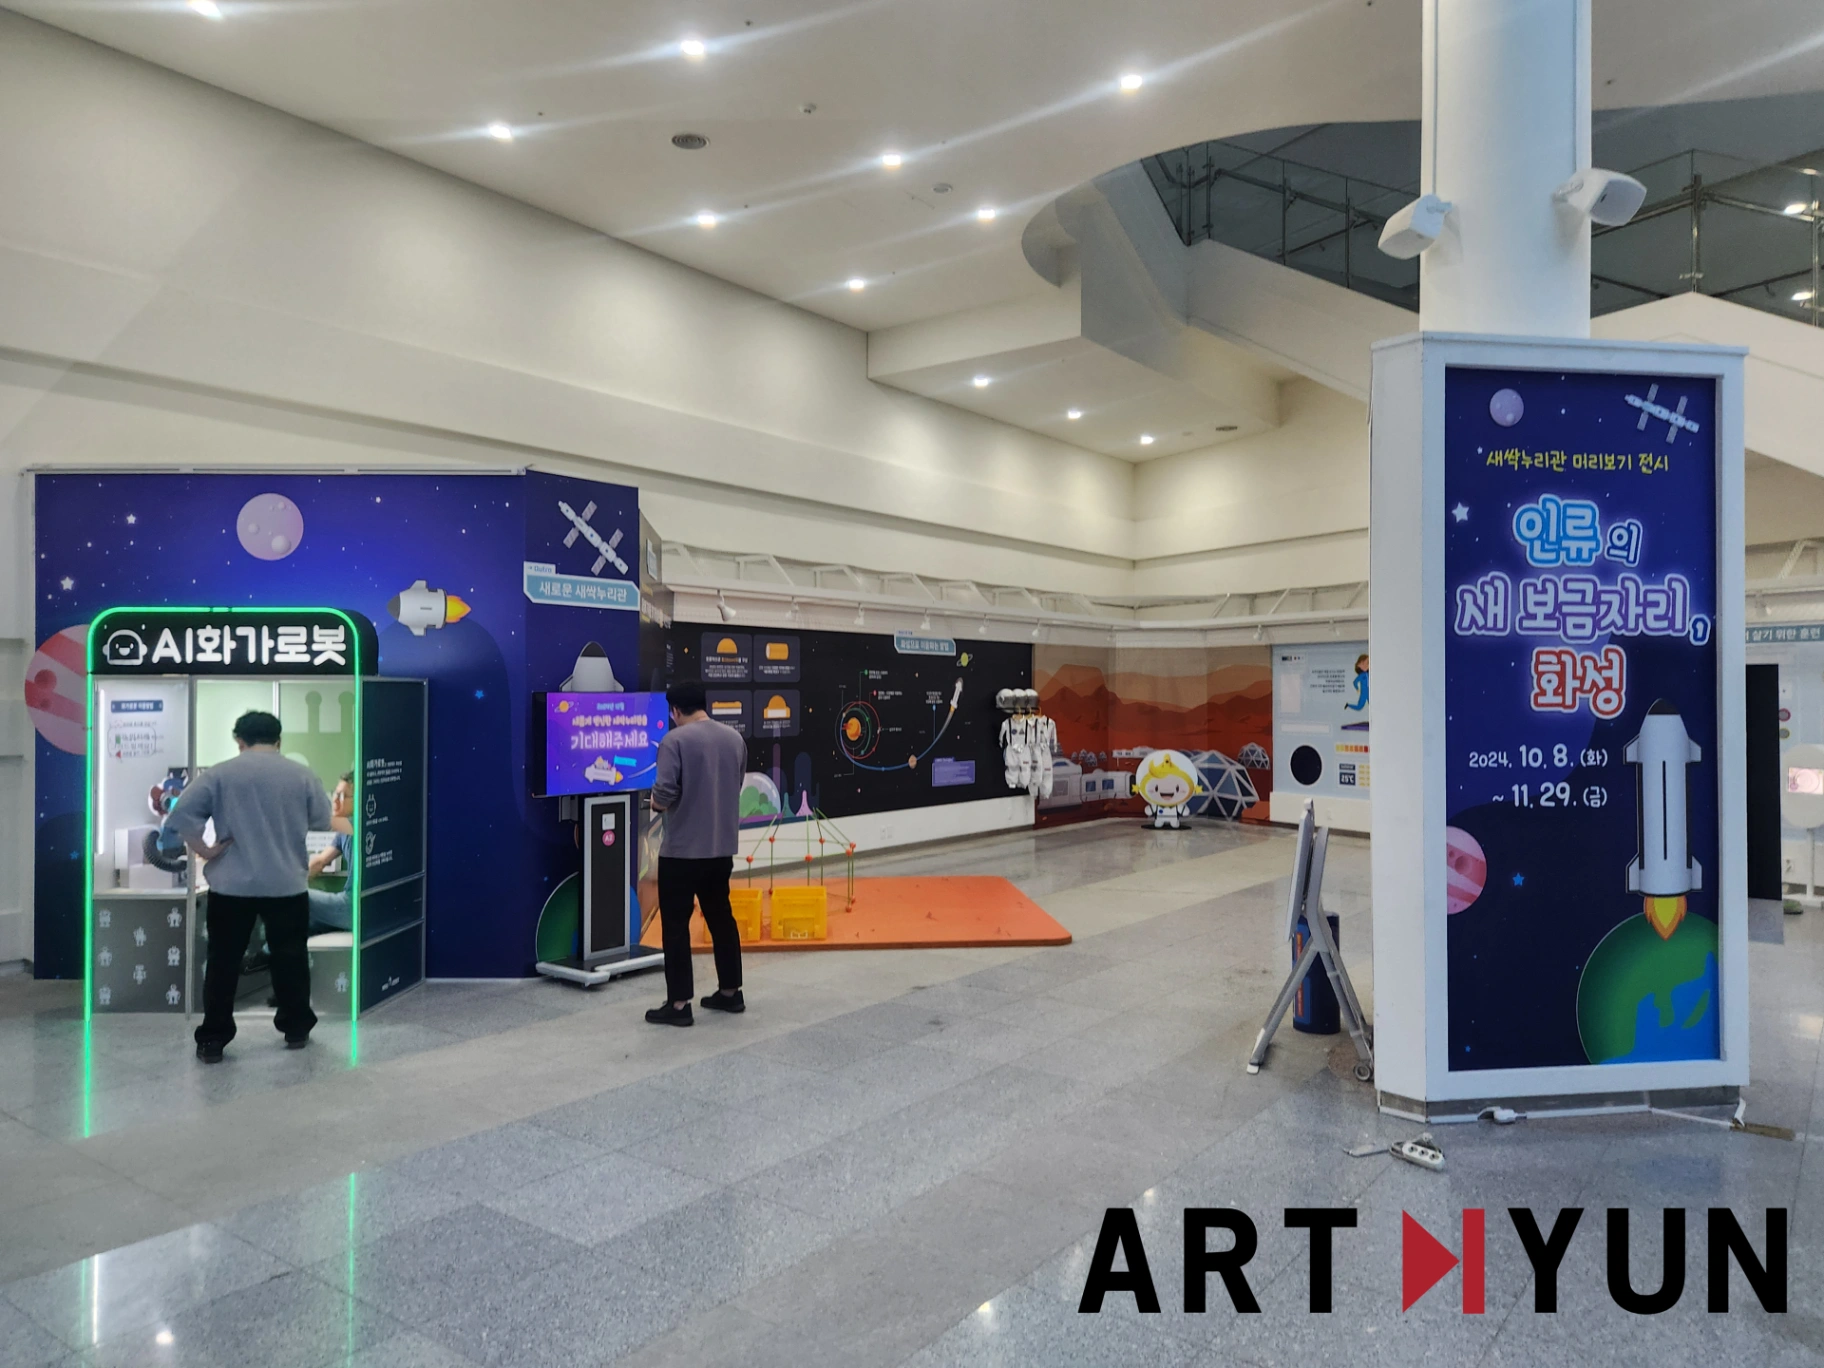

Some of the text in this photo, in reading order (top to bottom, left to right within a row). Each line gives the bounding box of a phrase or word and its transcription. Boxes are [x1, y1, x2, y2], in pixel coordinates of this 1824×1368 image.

[1486, 448, 1567, 472] 새싹누리관
[1638, 453, 1669, 474] 전시
[1513, 493, 1643, 567] 인류 의
[540, 581, 572, 597] 새로운
[575, 584, 627, 602] 새싹누리관
[1454, 572, 1711, 645] 새 보금자리,
[151, 624, 346, 666] AI화가로봇
[1530, 645, 1626, 719] 화성
[571, 729, 649, 750] 기대해주세요
[1469, 743, 1608, 769] 2024. 10. 8. (화)
[1511, 784, 1534, 809] 11.
[1539, 782, 1577, 807] 29.
[1583, 786, 1608, 808] (금)
